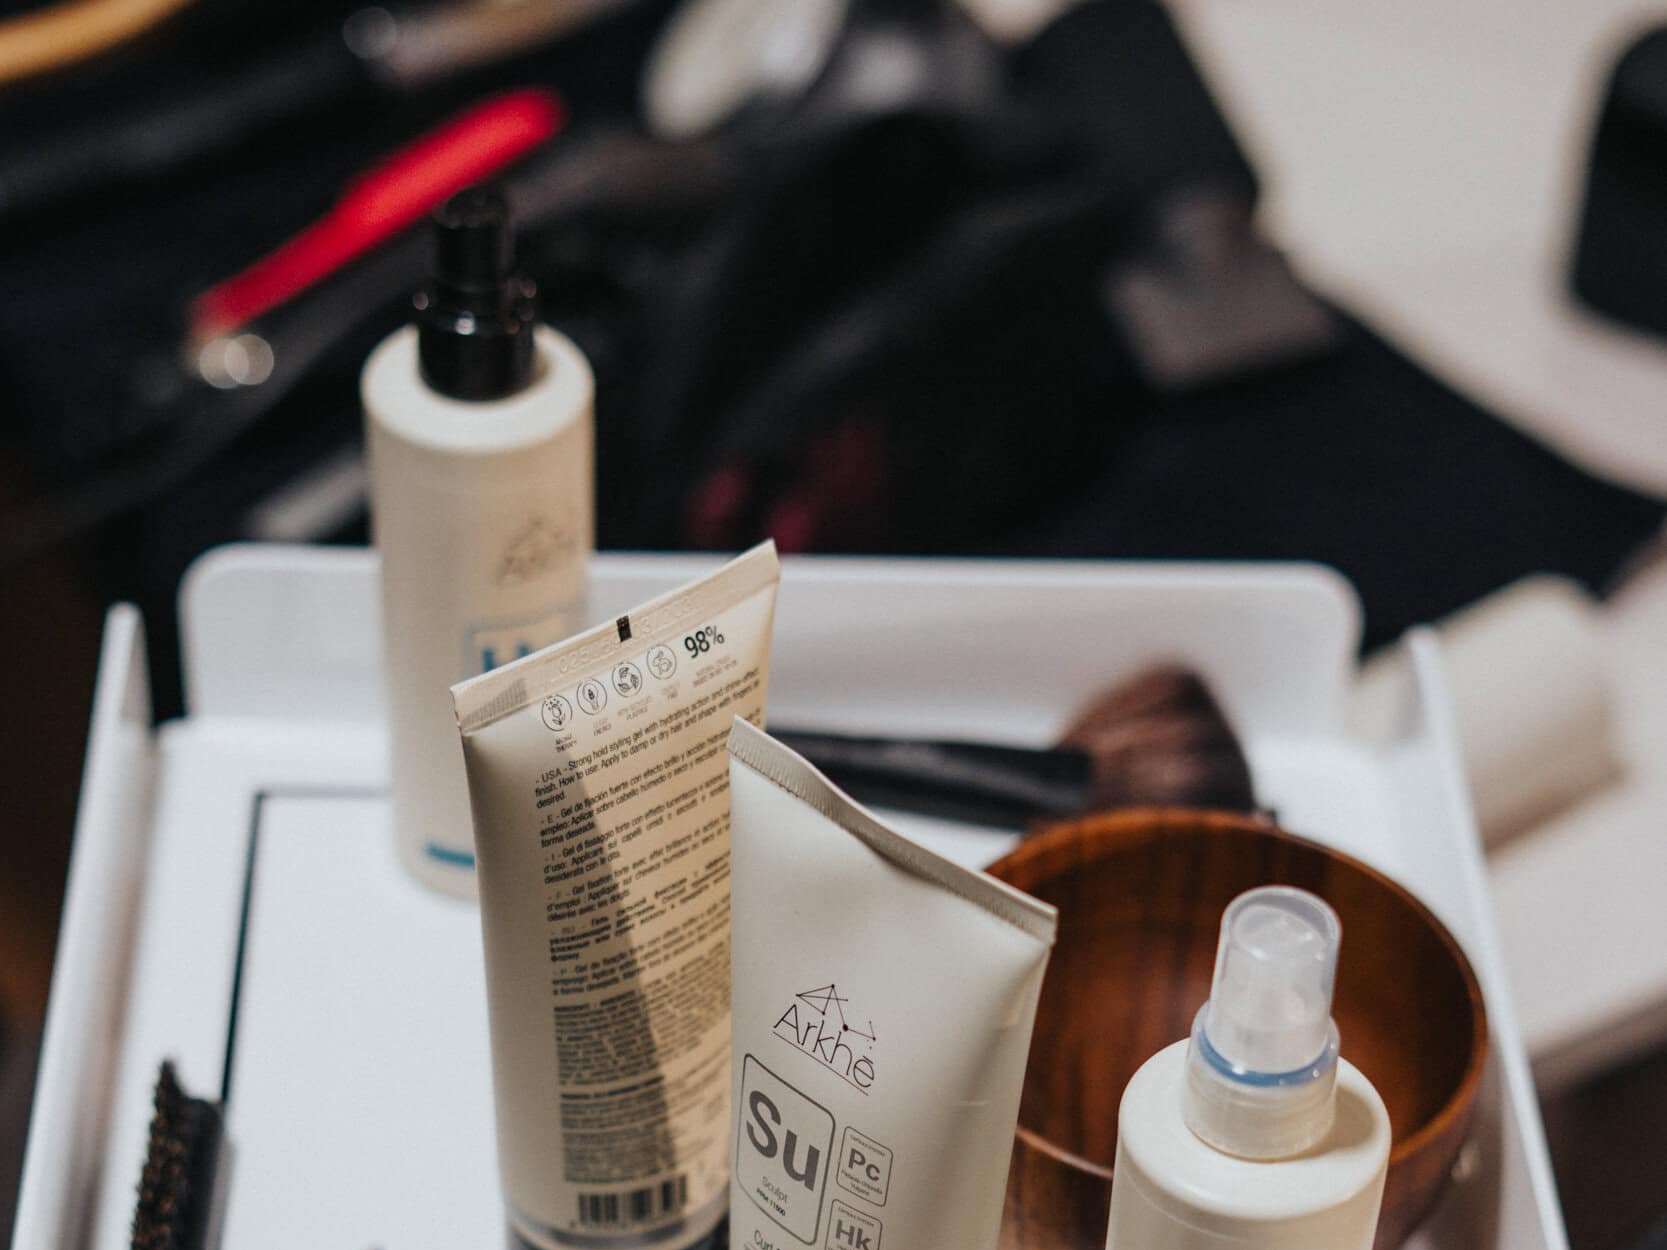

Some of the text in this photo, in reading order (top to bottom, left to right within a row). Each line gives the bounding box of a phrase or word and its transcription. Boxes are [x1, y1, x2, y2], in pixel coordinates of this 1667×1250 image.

[683, 625, 725, 659] 98%
[541, 767, 561, 784] USA
[746, 1088, 822, 1193] Su
[848, 1148, 881, 1182] Pc
